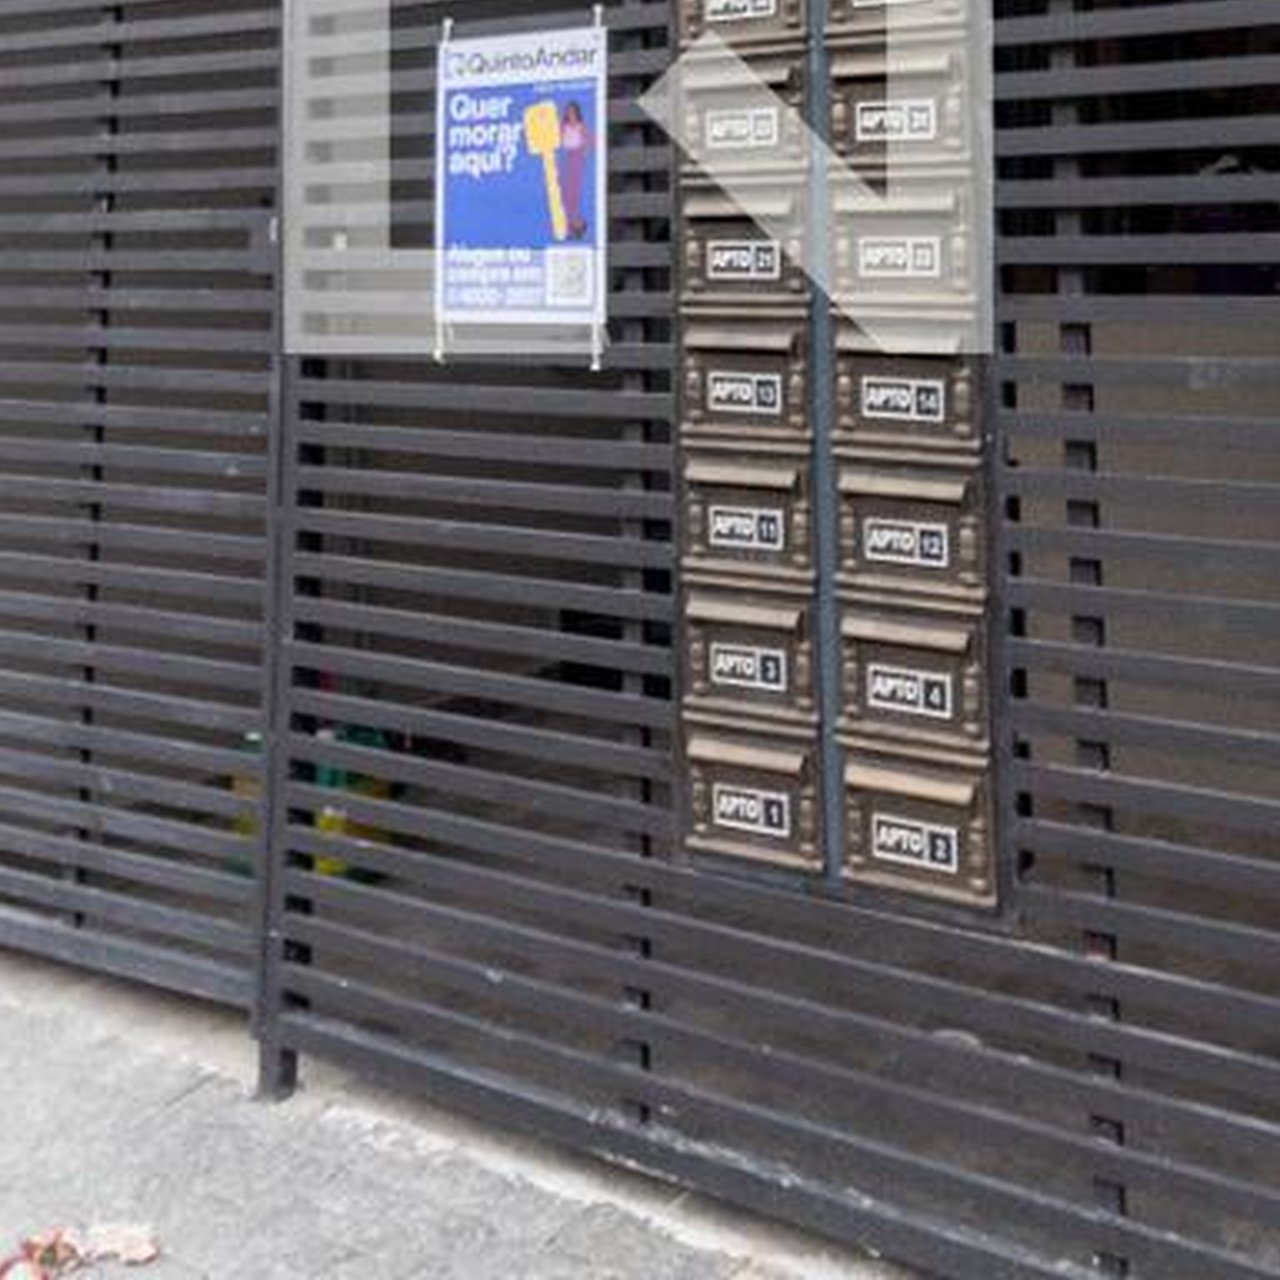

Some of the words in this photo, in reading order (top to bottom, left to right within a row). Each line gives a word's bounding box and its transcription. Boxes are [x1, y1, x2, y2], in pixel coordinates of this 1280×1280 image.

[467, 47, 597, 74] QuintoAndar
[450, 93, 513, 122] Quer
[449, 121, 522, 149] morar
[449, 145, 517, 178] aqui?
[712, 250, 751, 269] APTO
[863, 246, 908, 268] APTO
[712, 381, 753, 403] APTO
[867, 387, 911, 410] APTO
[713, 516, 755, 539] APTO
[760, 519, 779, 540] 11
[868, 530, 916, 553] APTO
[922, 535, 944, 556] 12
[715, 656, 755, 679] APTO
[872, 678, 919, 701] APTO
[928, 684, 941, 705] 4
[717, 798, 758, 821] APTO
[769, 804, 780, 824] 1
[876, 829, 922, 853] APTO
[933, 837, 948, 859] 2
